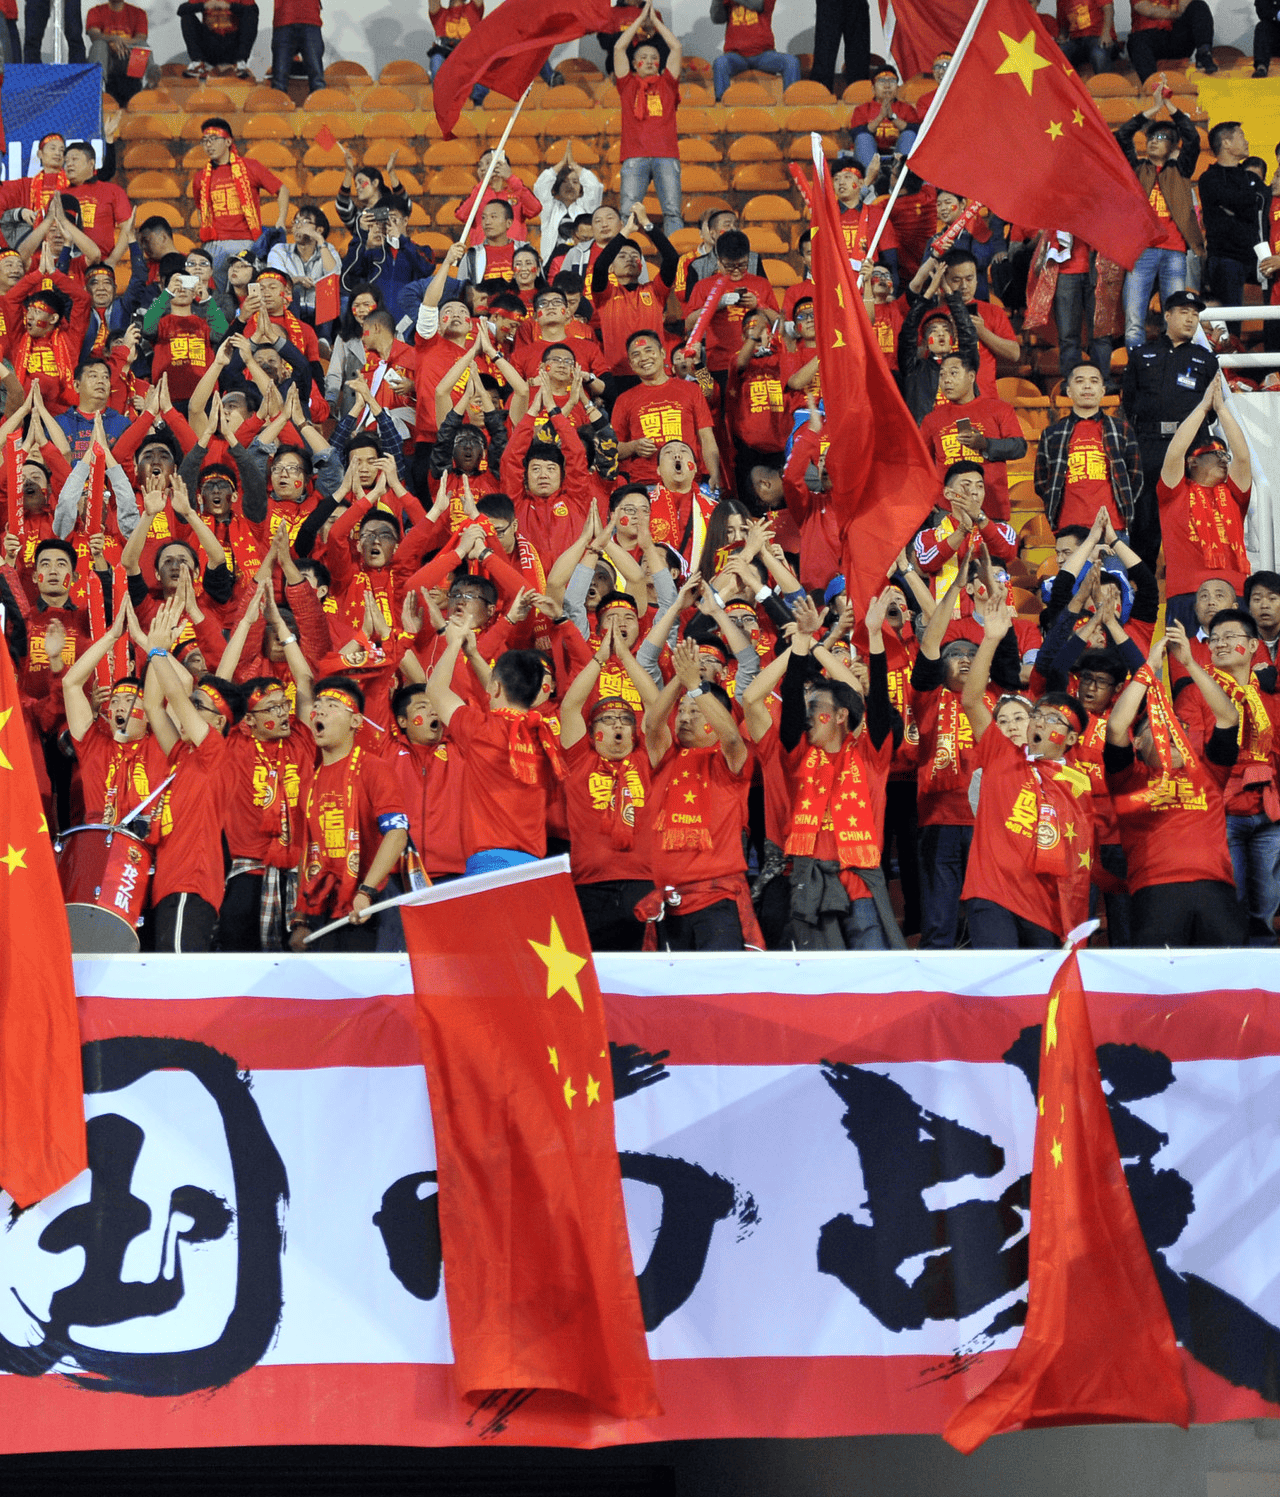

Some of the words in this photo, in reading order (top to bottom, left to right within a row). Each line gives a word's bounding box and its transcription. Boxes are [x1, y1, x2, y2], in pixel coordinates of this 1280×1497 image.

[671, 813, 702, 825] CHINA
[839, 831, 873, 842] CHINA
[114, 862, 139, 914] 龙之队
